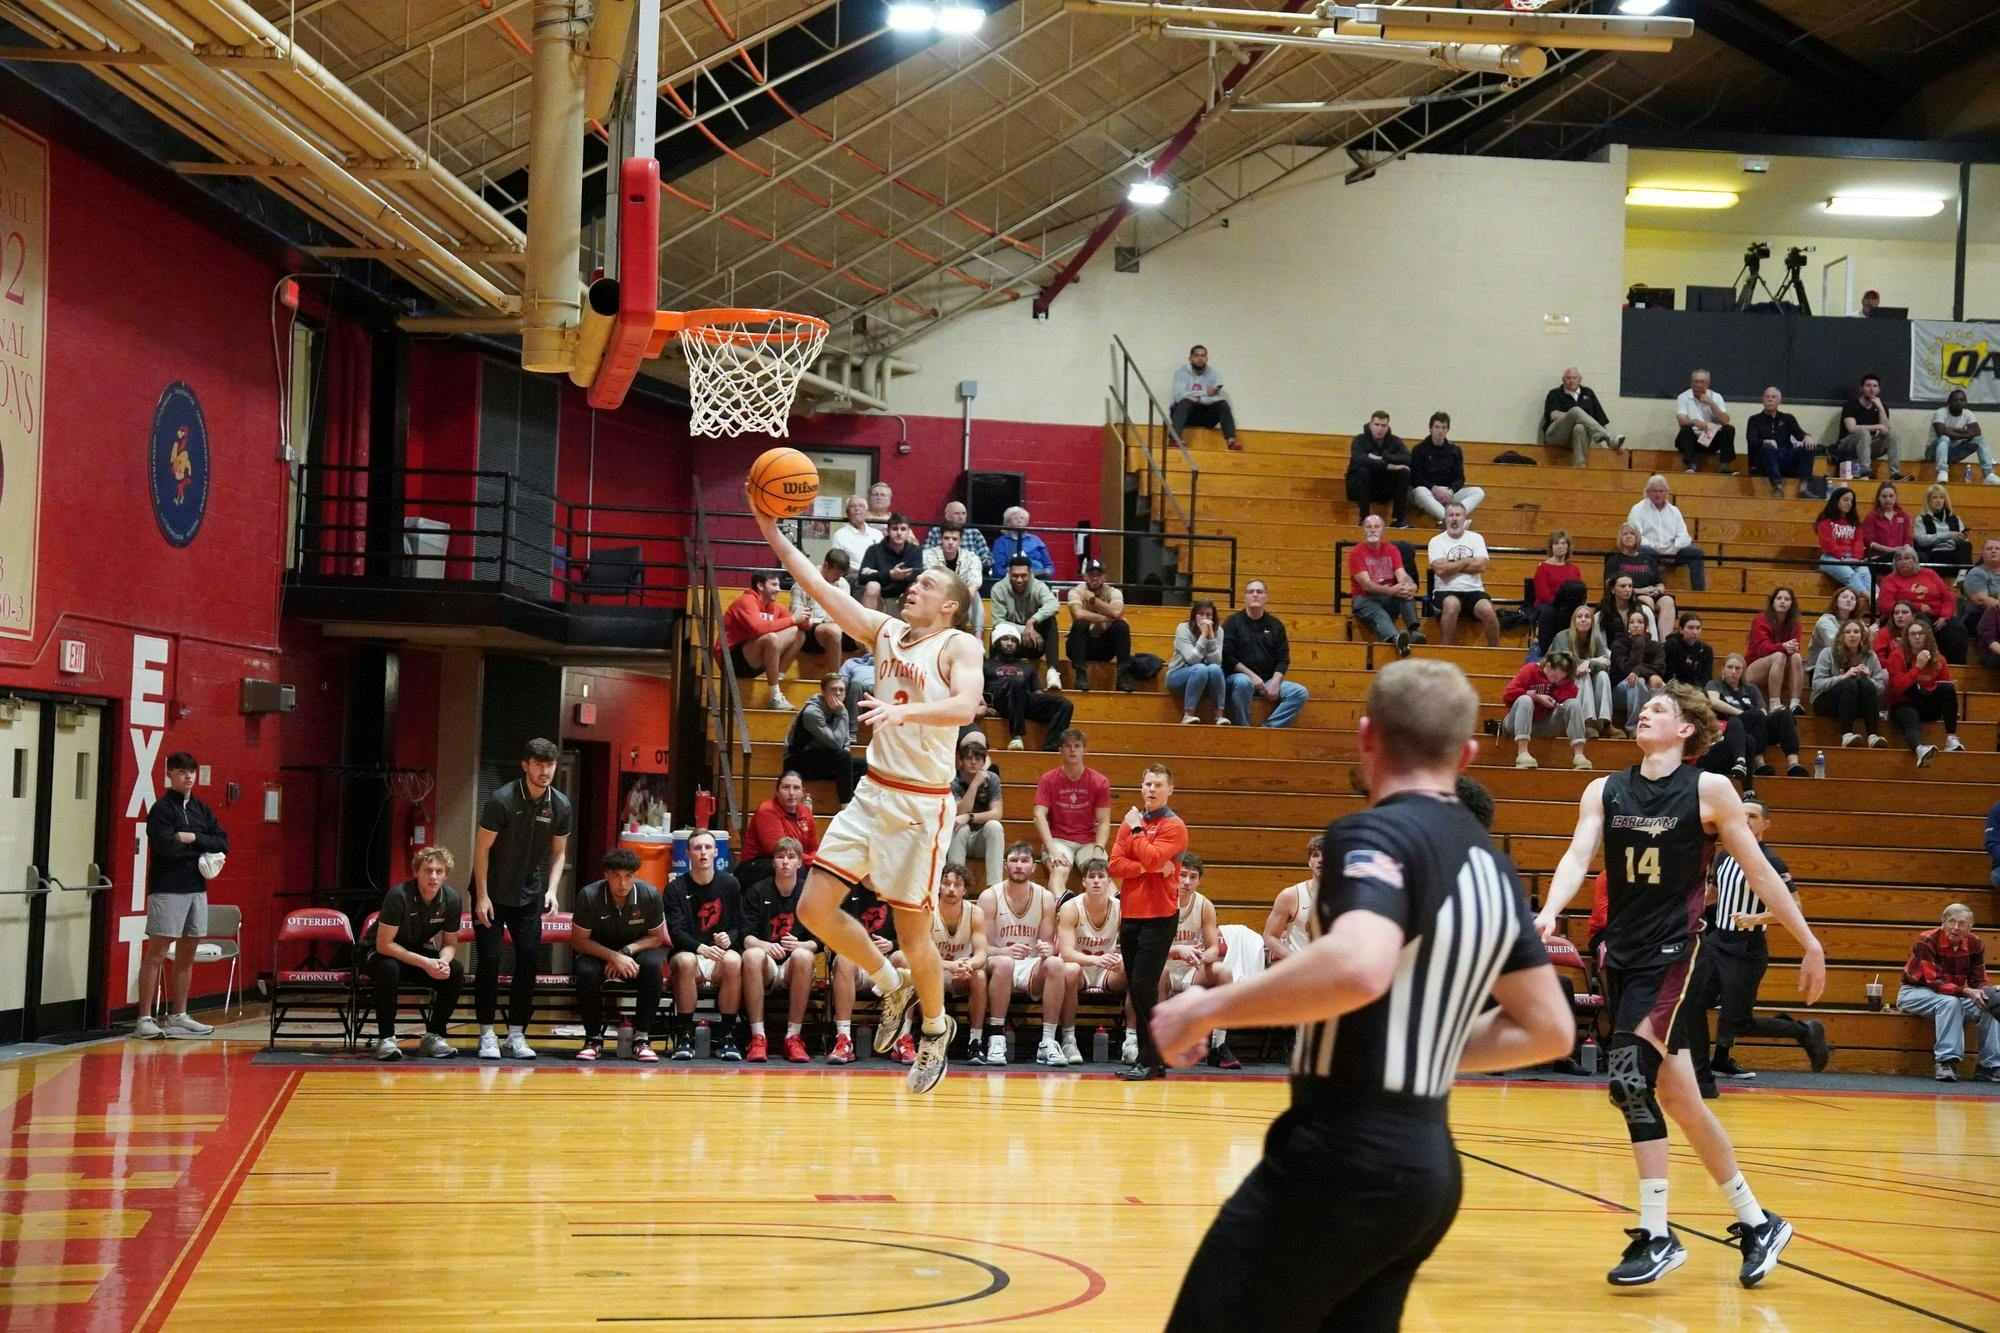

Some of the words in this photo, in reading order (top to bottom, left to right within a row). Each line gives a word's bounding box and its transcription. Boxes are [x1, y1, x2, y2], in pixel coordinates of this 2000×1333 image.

[69, 642, 84, 671] EXIT
[117, 634, 169, 1004] EXIT
[1625, 846, 1661, 884] 14
[287, 916, 345, 927] OTTERBEIN
[288, 973, 339, 982] CARDINALS
